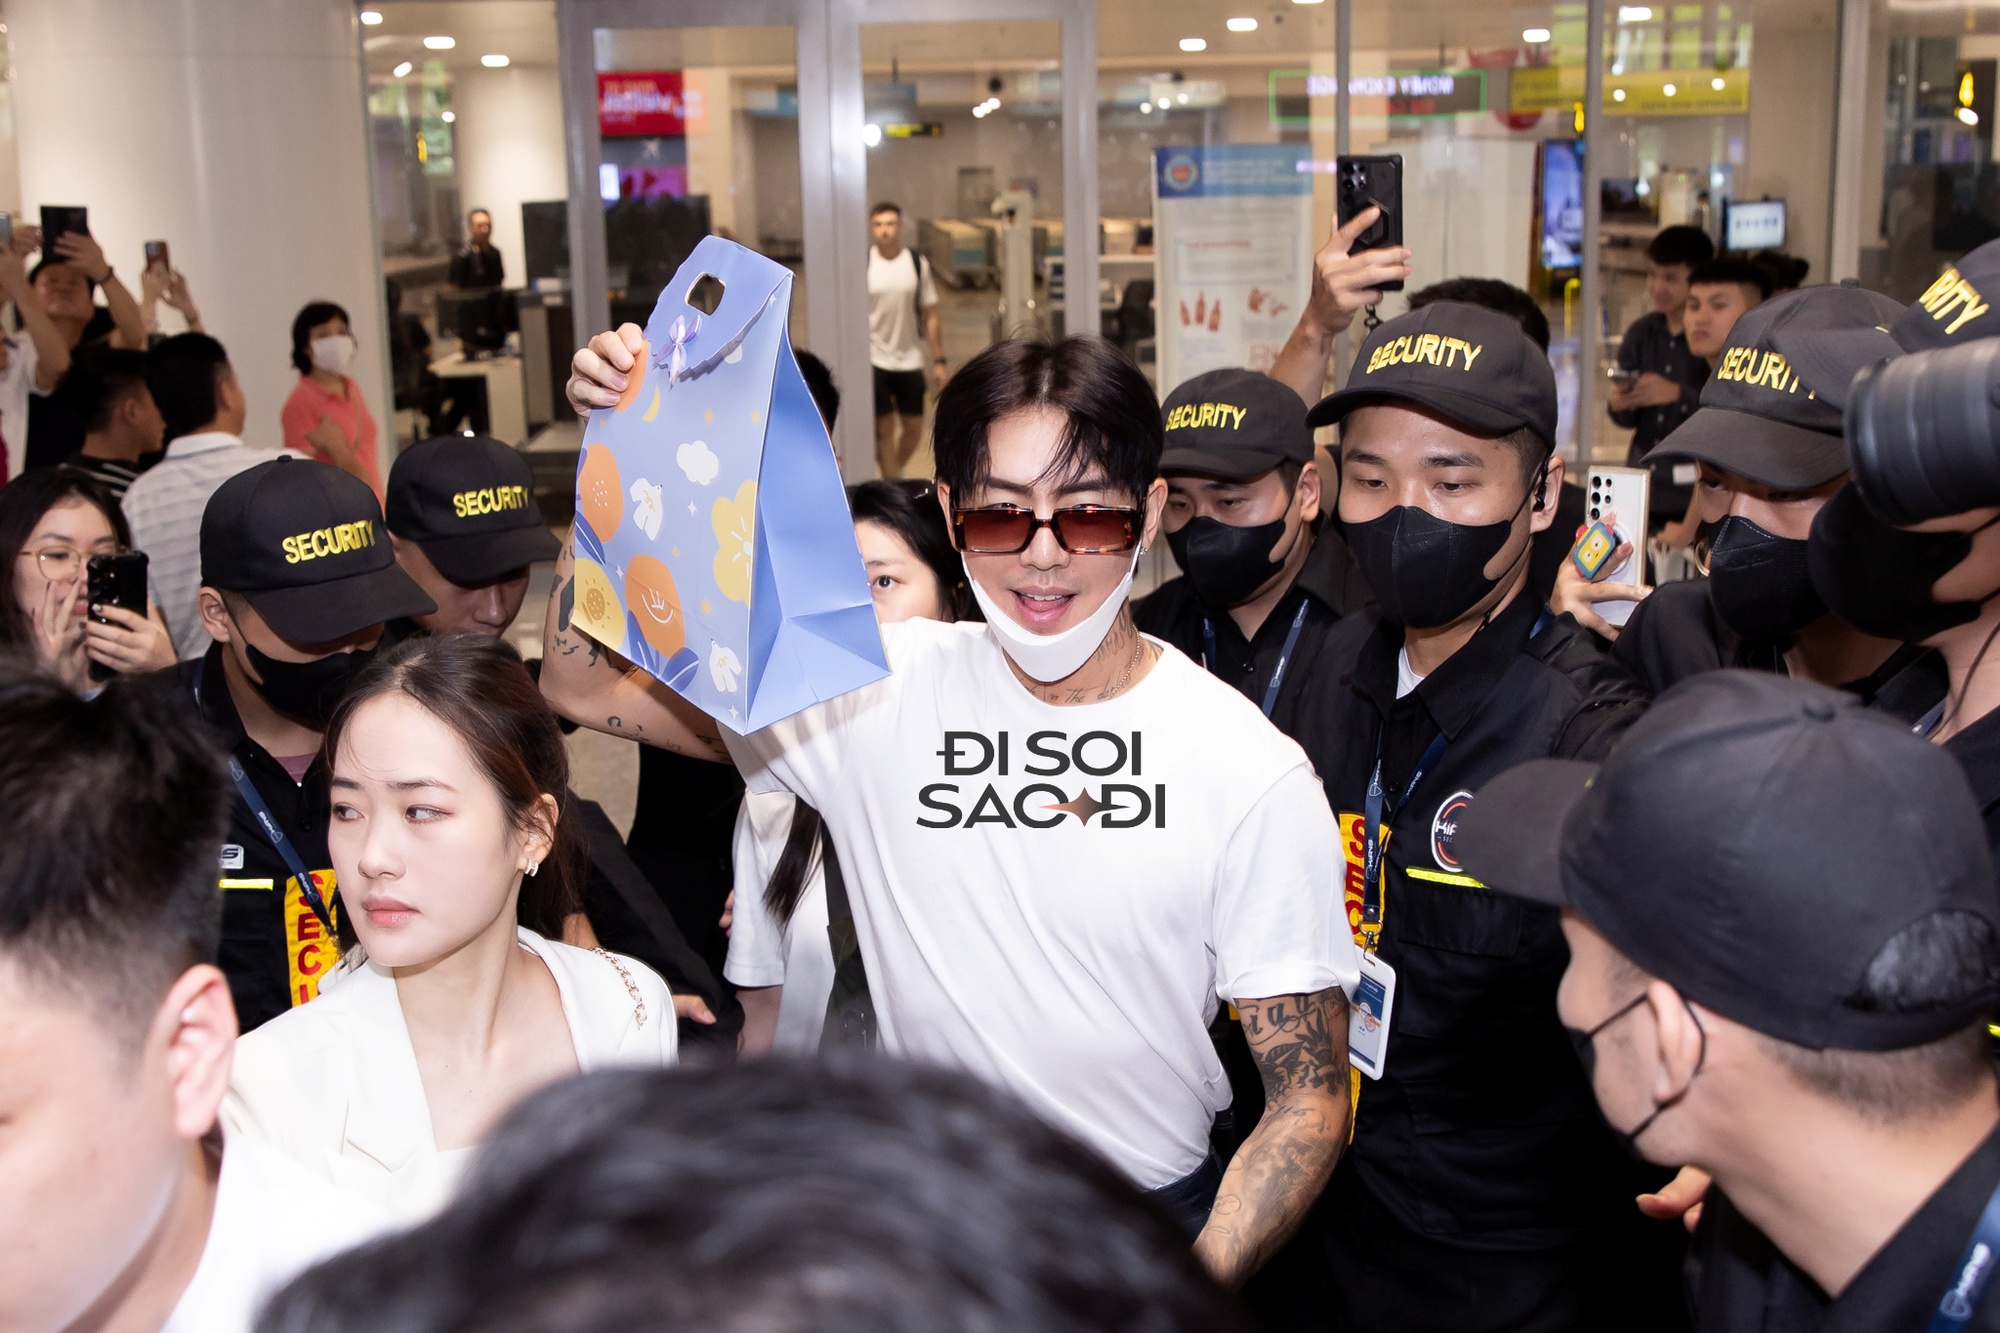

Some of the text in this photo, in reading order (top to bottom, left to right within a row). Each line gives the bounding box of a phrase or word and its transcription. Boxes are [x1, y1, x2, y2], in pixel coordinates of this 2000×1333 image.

[1366, 333, 1483, 375] SECURITY
[1165, 402, 1247, 432] SECURITY
[453, 485, 529, 518] SECURITY
[282, 519, 376, 564] SECURITY
[1024, 730, 1142, 777] SOI
